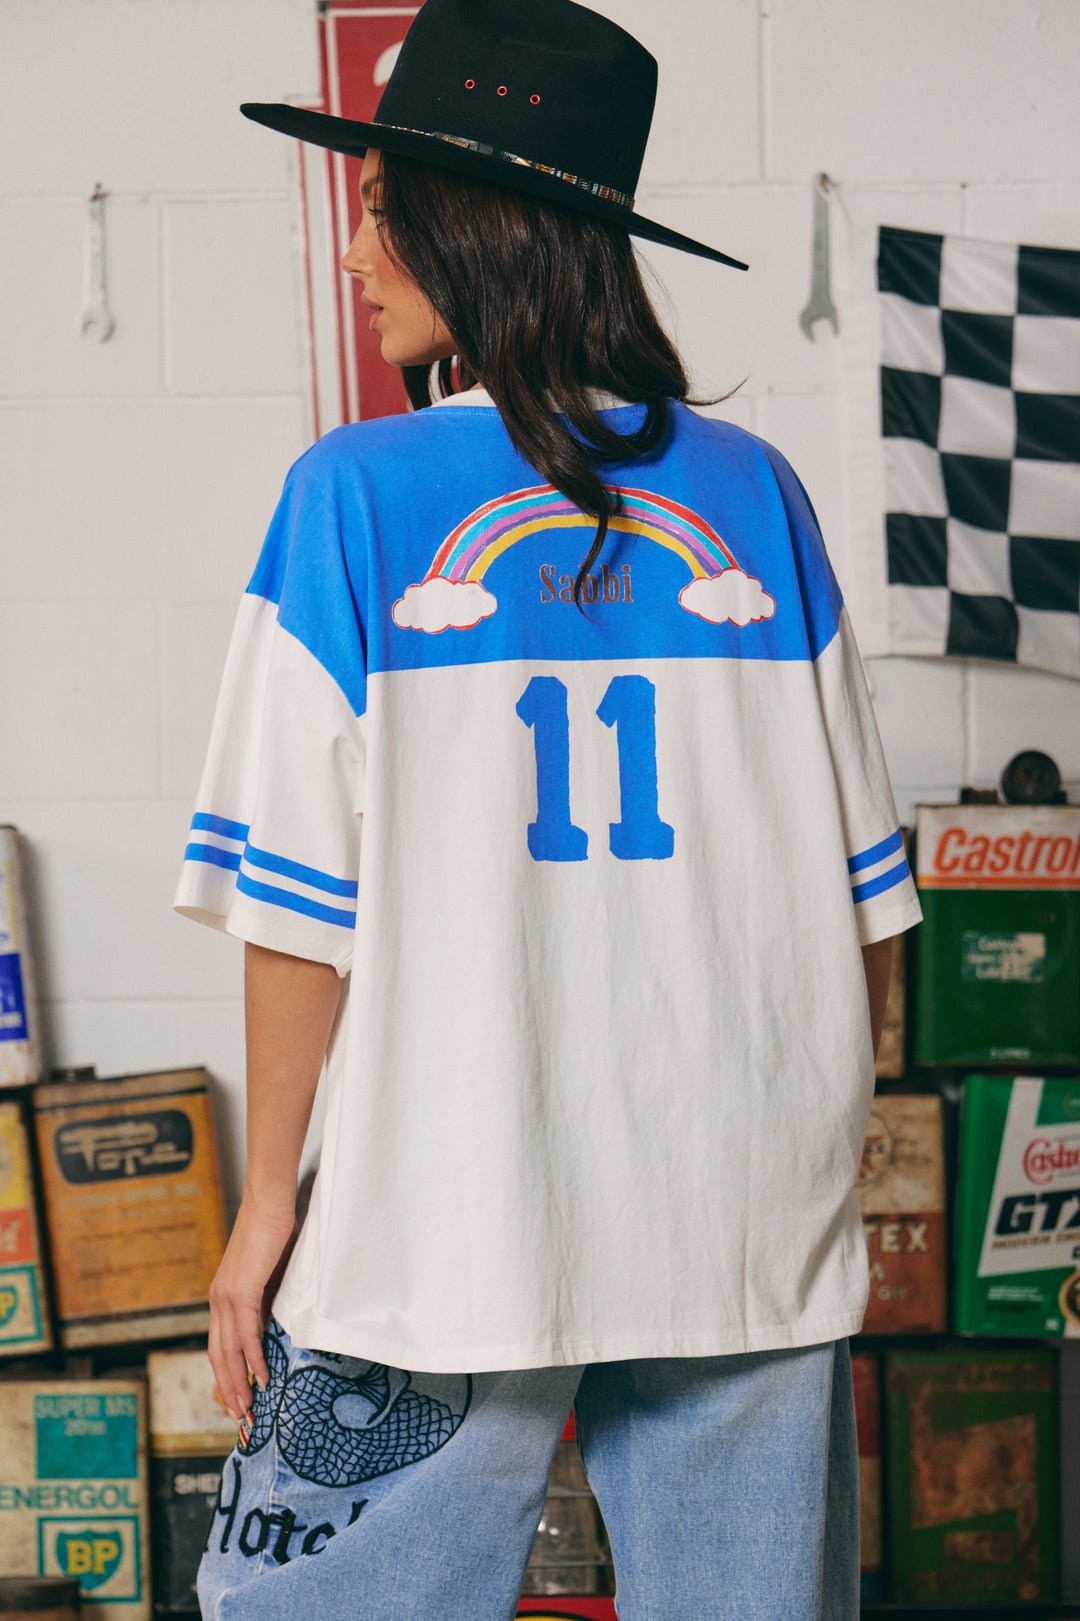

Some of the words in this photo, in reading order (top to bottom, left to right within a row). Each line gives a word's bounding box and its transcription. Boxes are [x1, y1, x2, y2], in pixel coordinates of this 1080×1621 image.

[515, 675, 675, 862] 11
[932, 827, 1080, 876] Castrol
[0, 1484, 138, 1511] ENERGOL
[174, 1473, 221, 1494] SHE
[65, 1539, 119, 1575] BP
